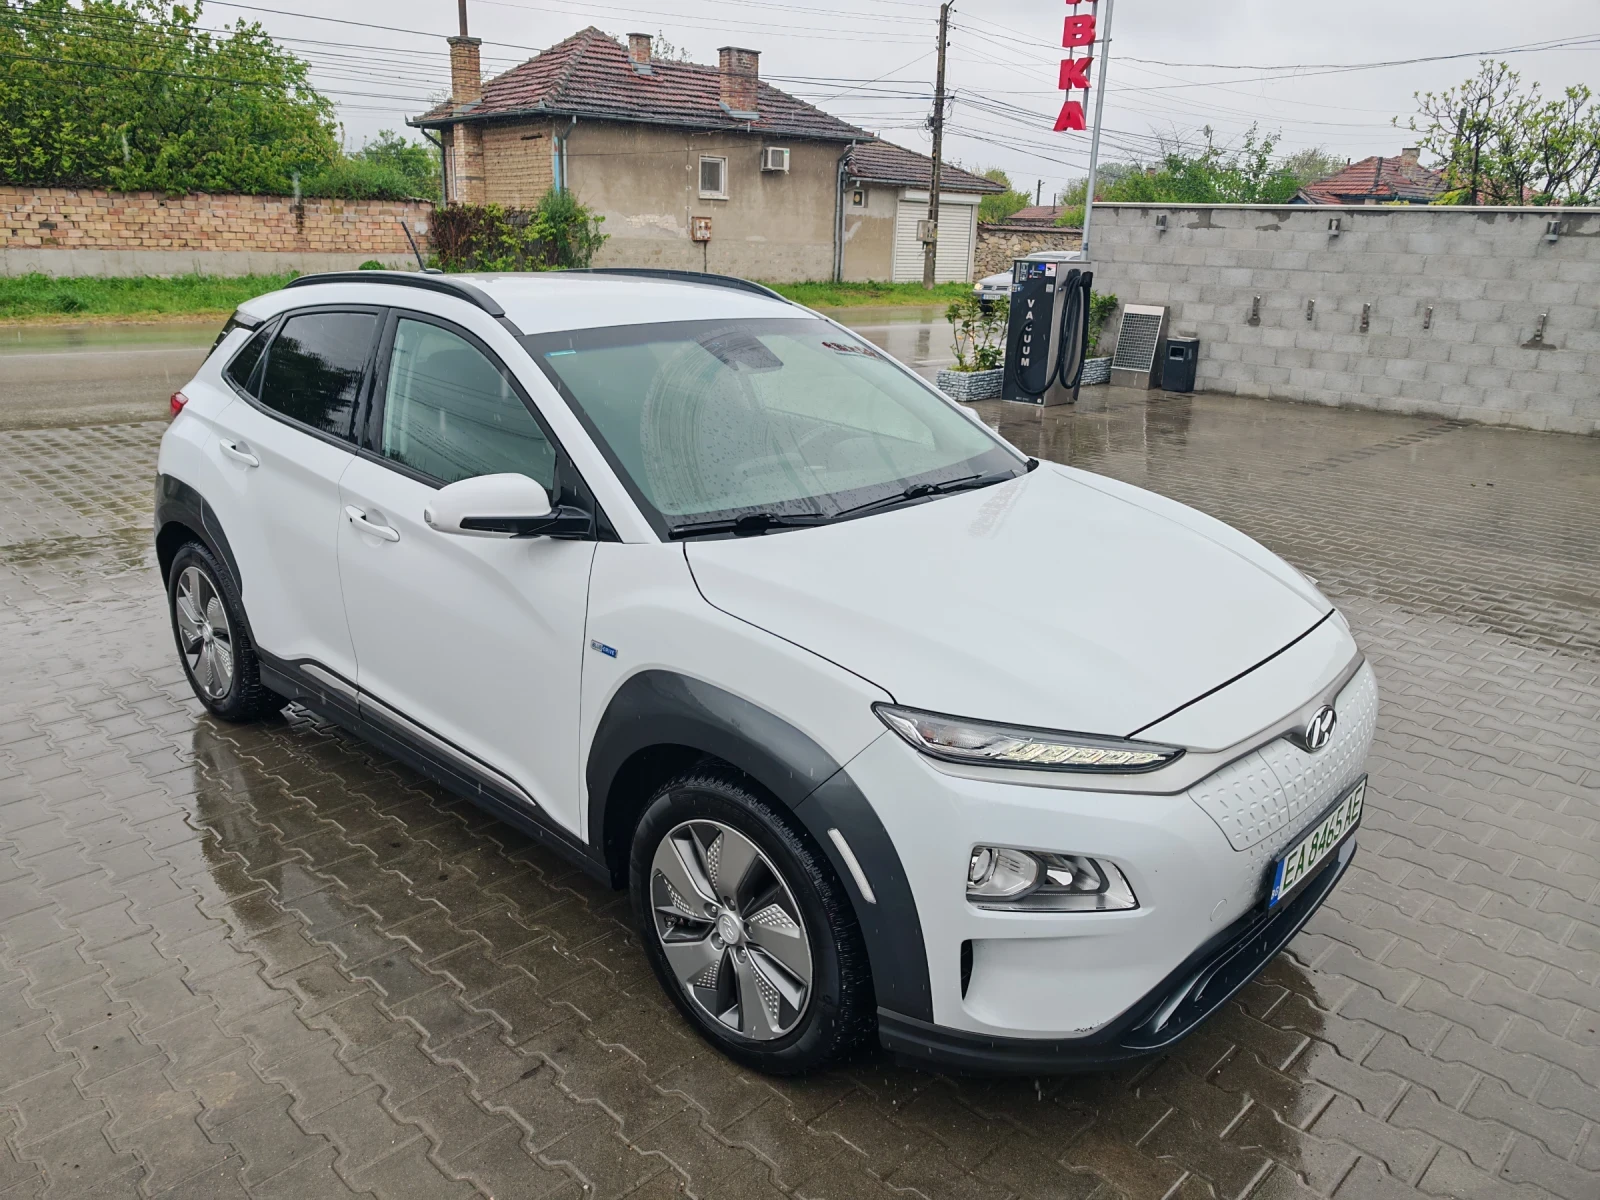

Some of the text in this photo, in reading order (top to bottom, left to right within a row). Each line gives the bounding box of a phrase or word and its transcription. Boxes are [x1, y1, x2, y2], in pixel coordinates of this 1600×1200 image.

[1053, 0, 1098, 131] ВКА
[1283, 785, 1363, 891] EA 8465 AE
